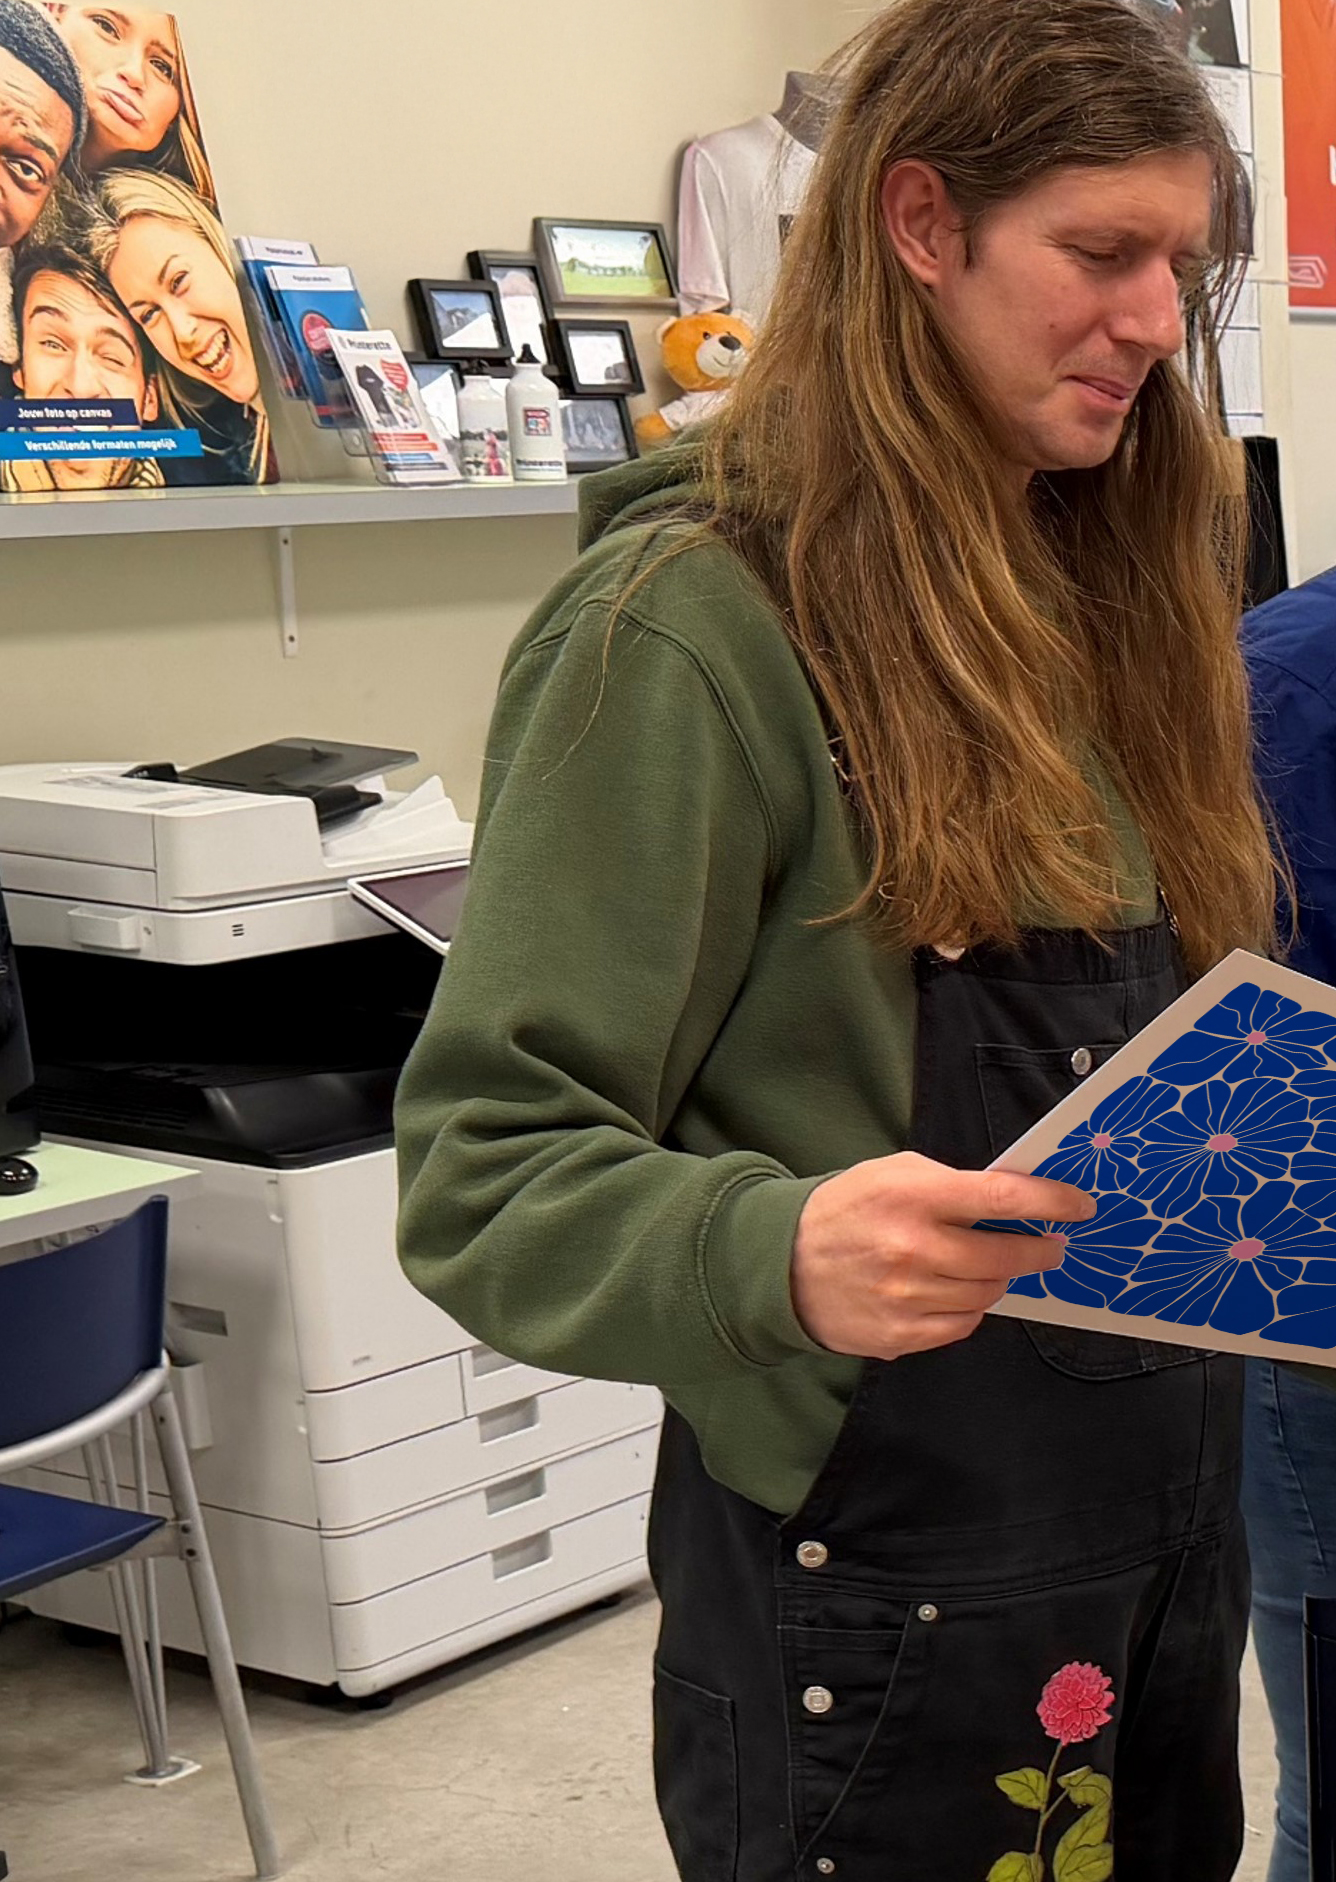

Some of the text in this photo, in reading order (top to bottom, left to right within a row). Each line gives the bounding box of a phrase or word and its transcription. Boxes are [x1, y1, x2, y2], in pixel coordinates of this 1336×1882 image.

[18, 407, 112, 420] Jouw foto op canvas
[25, 438, 177, 451] Verschillende formaten mogelijk
